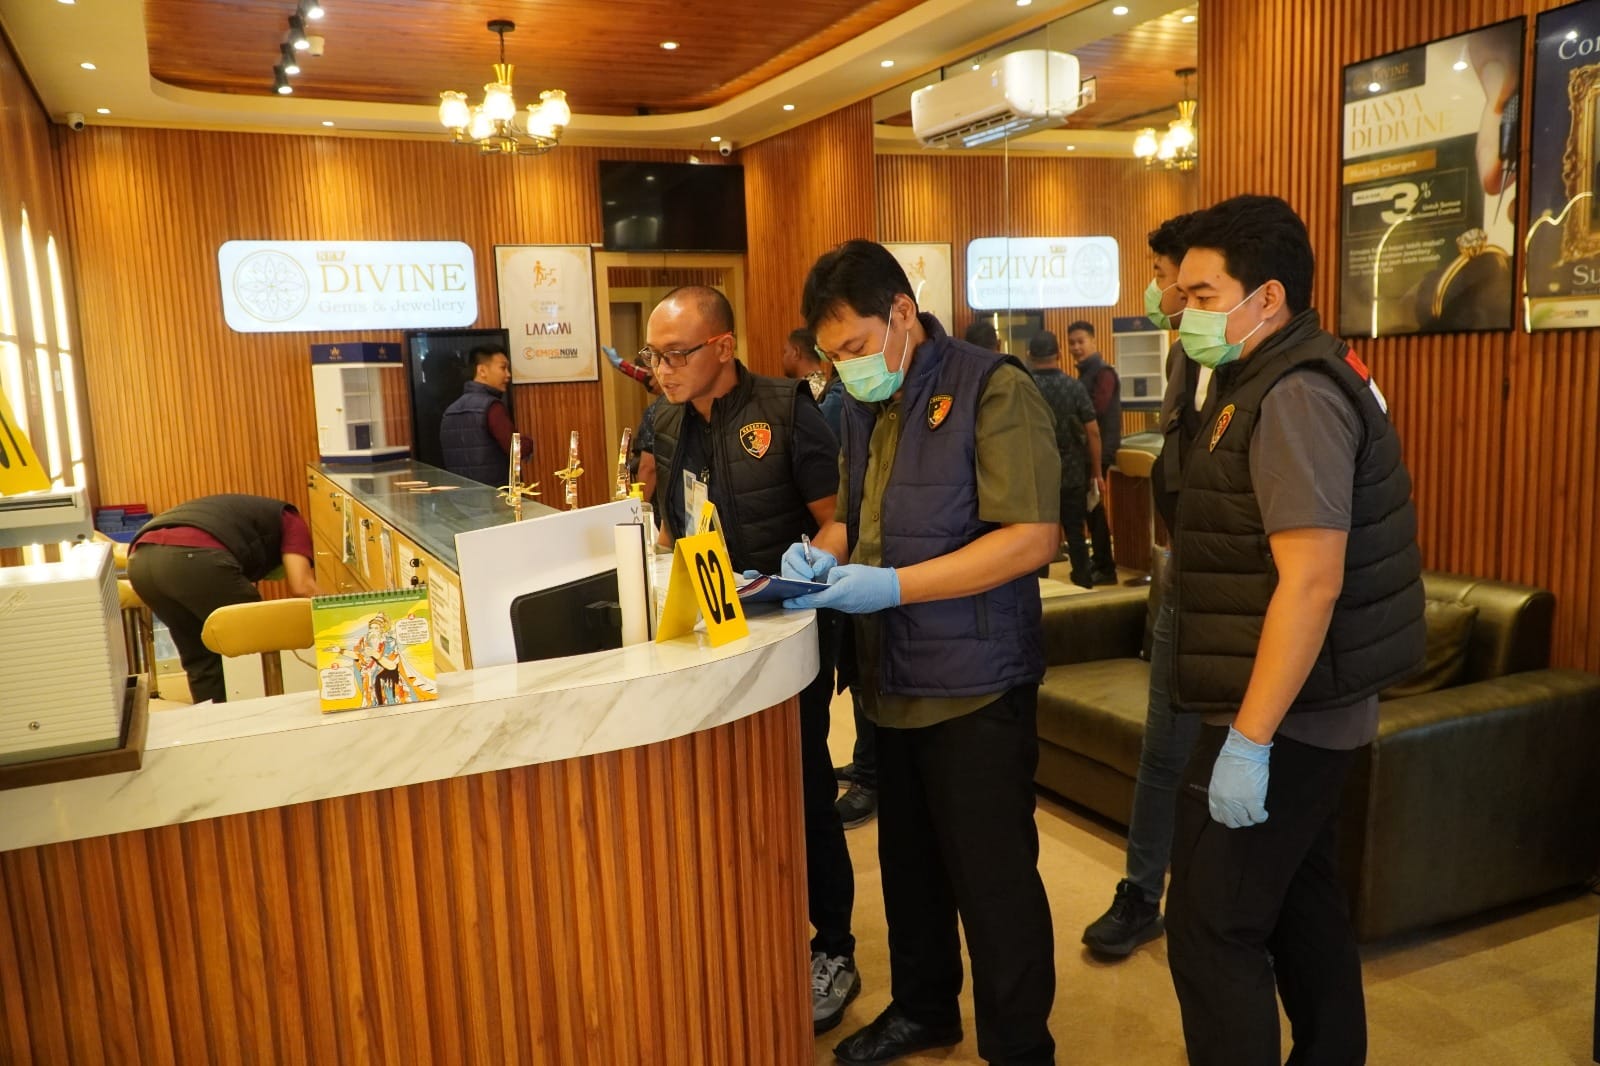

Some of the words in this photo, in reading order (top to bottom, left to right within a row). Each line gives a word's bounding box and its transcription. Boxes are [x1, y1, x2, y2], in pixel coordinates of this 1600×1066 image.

[1559, 36, 1600, 60] Co
[1351, 92, 1424, 128] HANYA
[1351, 127, 1372, 152] DI
[1378, 111, 1454, 146] DIVINE
[319, 263, 466, 293] DIVINE
[318, 301, 367, 313] Gems
[372, 300, 387, 312] &
[390, 296, 466, 314] Jewellery
[695, 549, 736, 624] 02
